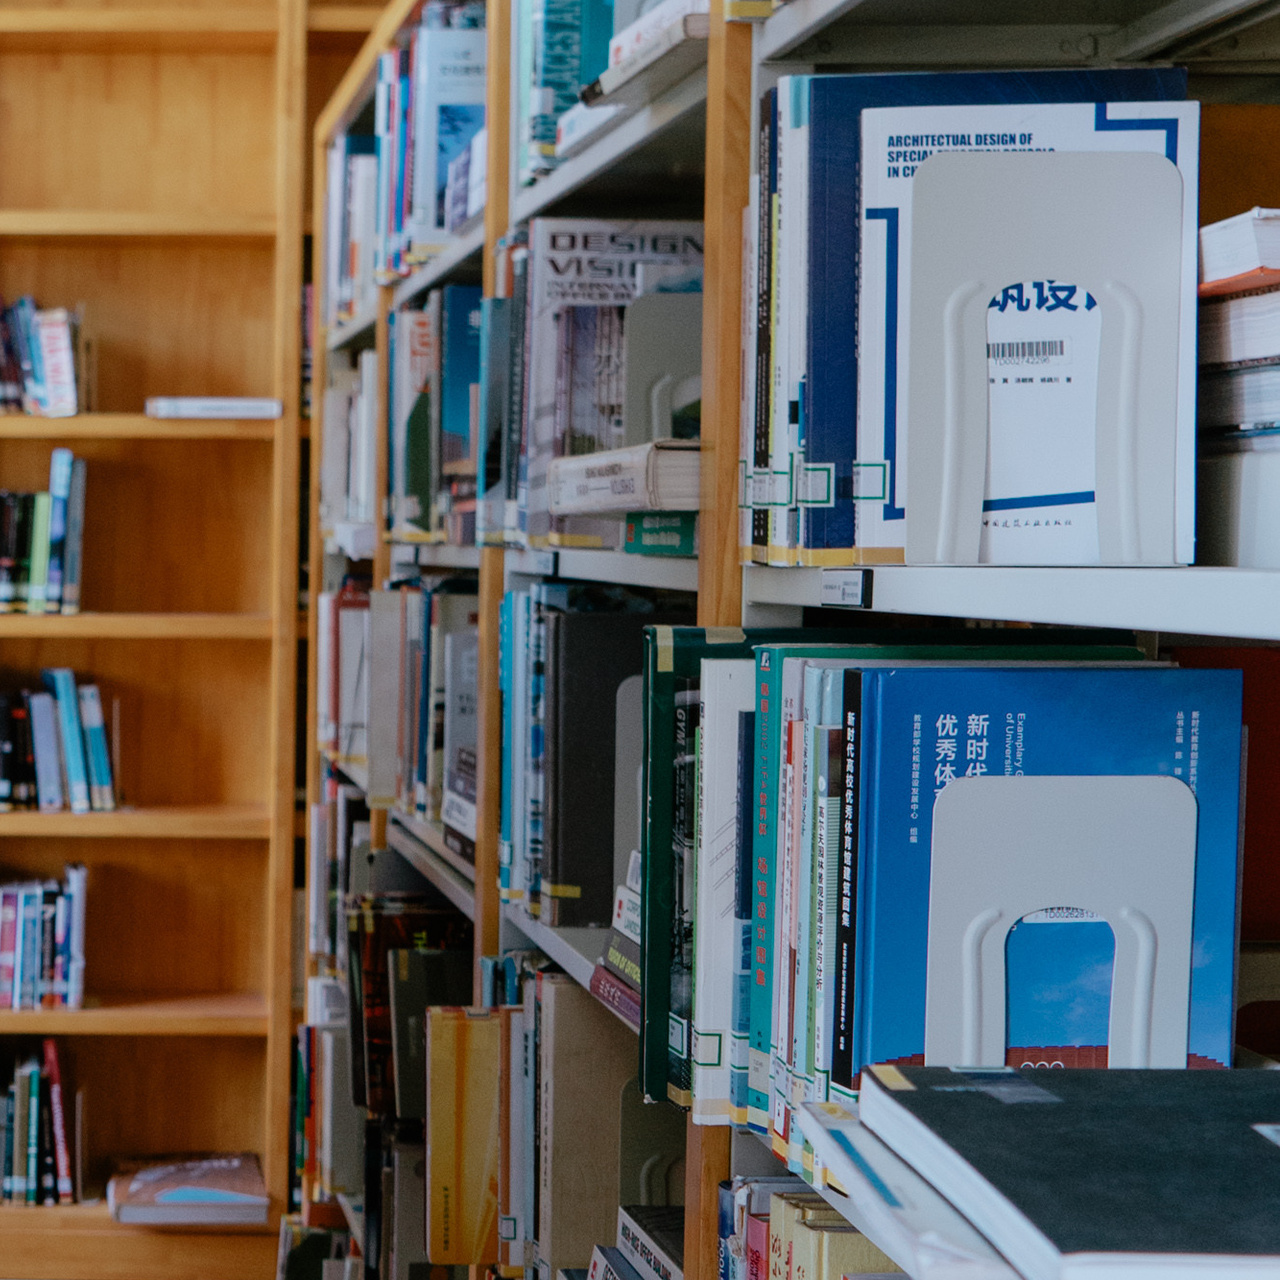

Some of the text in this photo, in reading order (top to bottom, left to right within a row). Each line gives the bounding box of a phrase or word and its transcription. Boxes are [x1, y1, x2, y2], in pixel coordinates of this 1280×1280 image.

[888, 132, 1033, 148] ARCHITECTUAL DESIGN OF
[888, 166, 899, 178] IN
[549, 231, 704, 254] DESIGN
[675, 708, 687, 746] GYM
[1005, 713, 1014, 725] of
[965, 713, 989, 777] 新时代
[1016, 712, 1026, 769] Examplary
[934, 714, 959, 800] 优秀体
